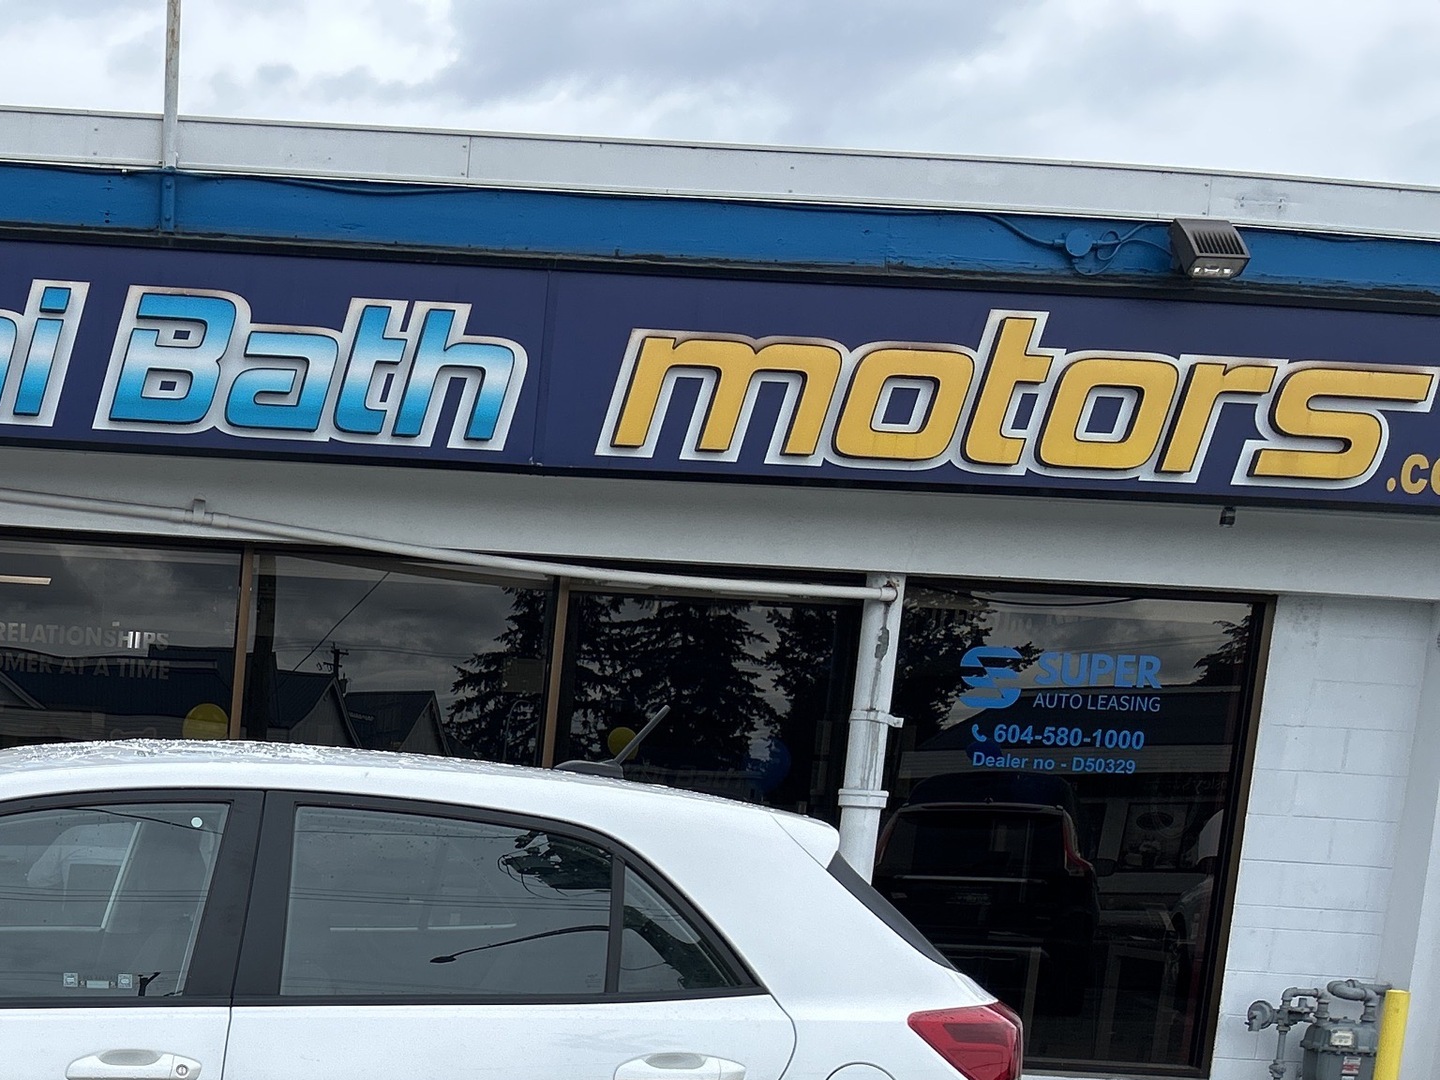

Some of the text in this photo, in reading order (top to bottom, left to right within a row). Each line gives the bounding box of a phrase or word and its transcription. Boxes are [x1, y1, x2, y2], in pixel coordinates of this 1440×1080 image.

[94, 286, 527, 450] Bath
[92, 657, 110, 677] A
[116, 658, 170, 680] TIME
[1034, 651, 1163, 689] SUPER
[1032, 693, 1161, 713] AUTO LEASING
[993, 723, 1145, 750] 604-580-1000
[972, 751, 1028, 769] Dealer
[1032, 758, 1055, 771] no
[1071, 757, 1137, 775] D50329
